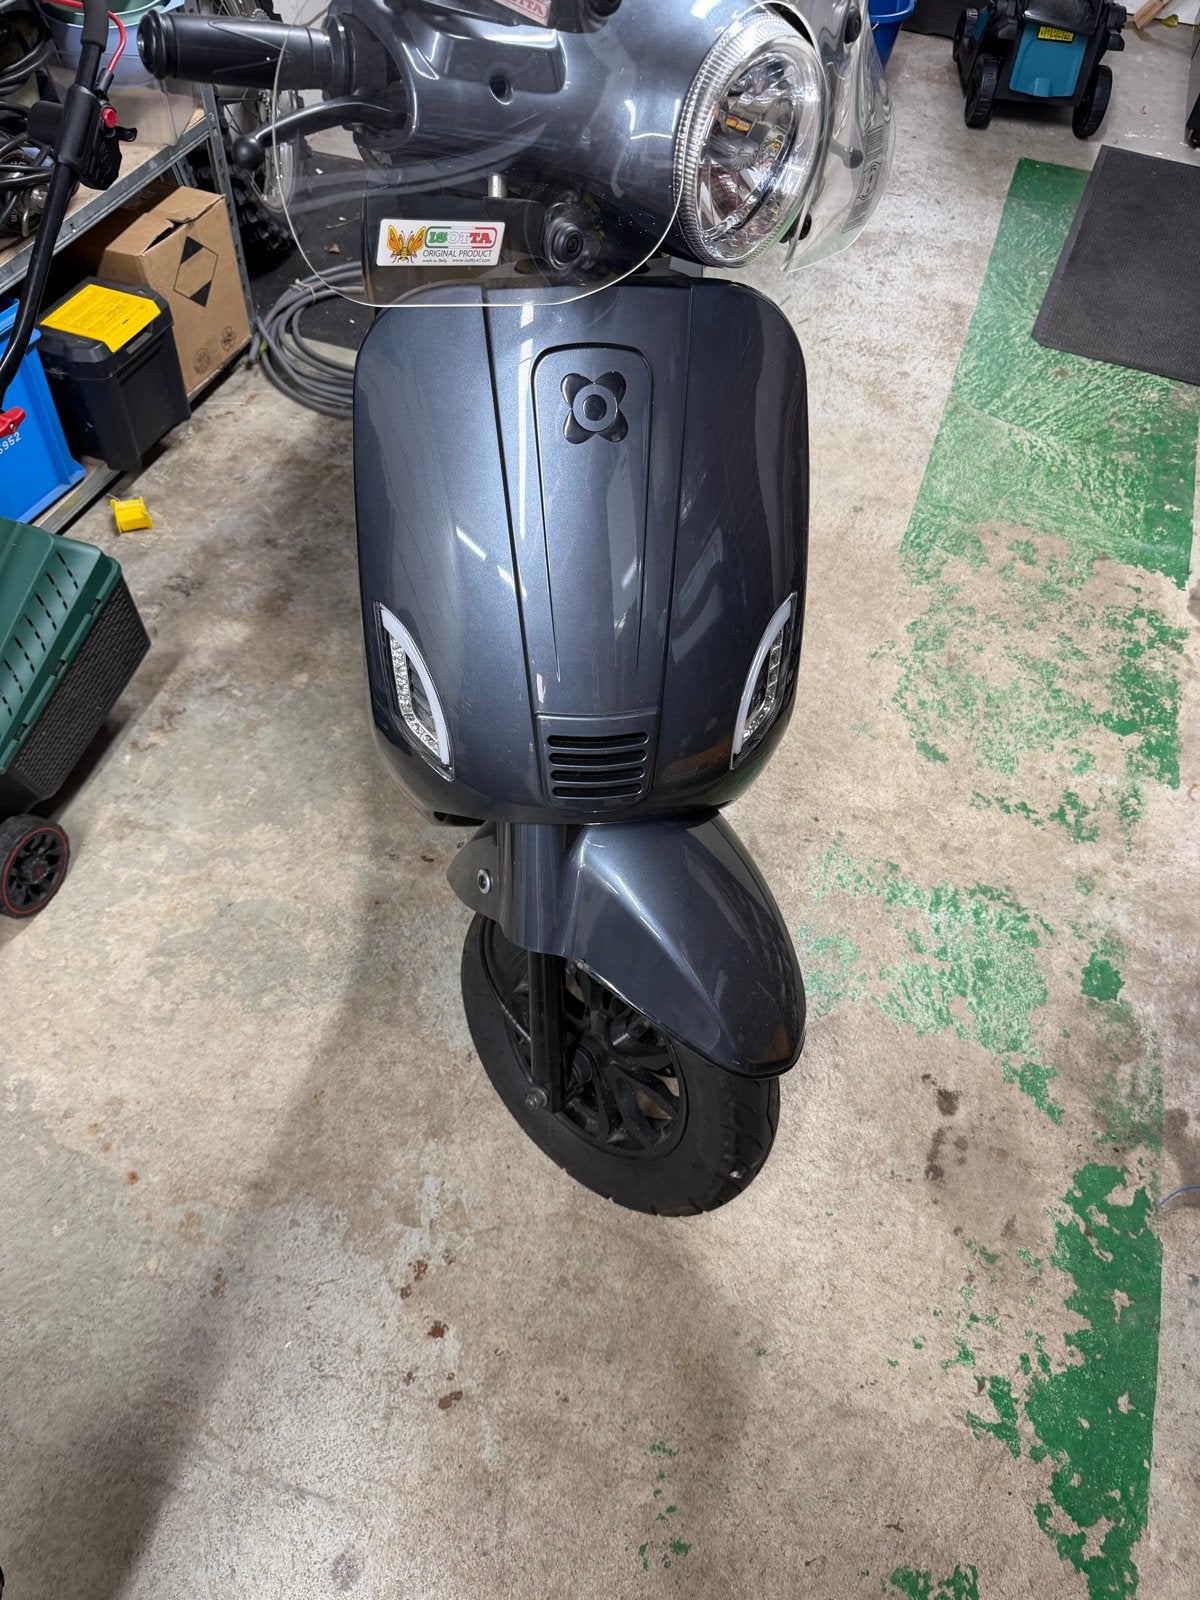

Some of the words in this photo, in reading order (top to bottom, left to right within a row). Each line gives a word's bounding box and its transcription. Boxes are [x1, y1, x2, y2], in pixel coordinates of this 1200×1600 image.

[428, 231, 493, 244] ISOTTA
[422, 249, 457, 258] ORIGINAL
[458, 249, 493, 258] PRODUCT
